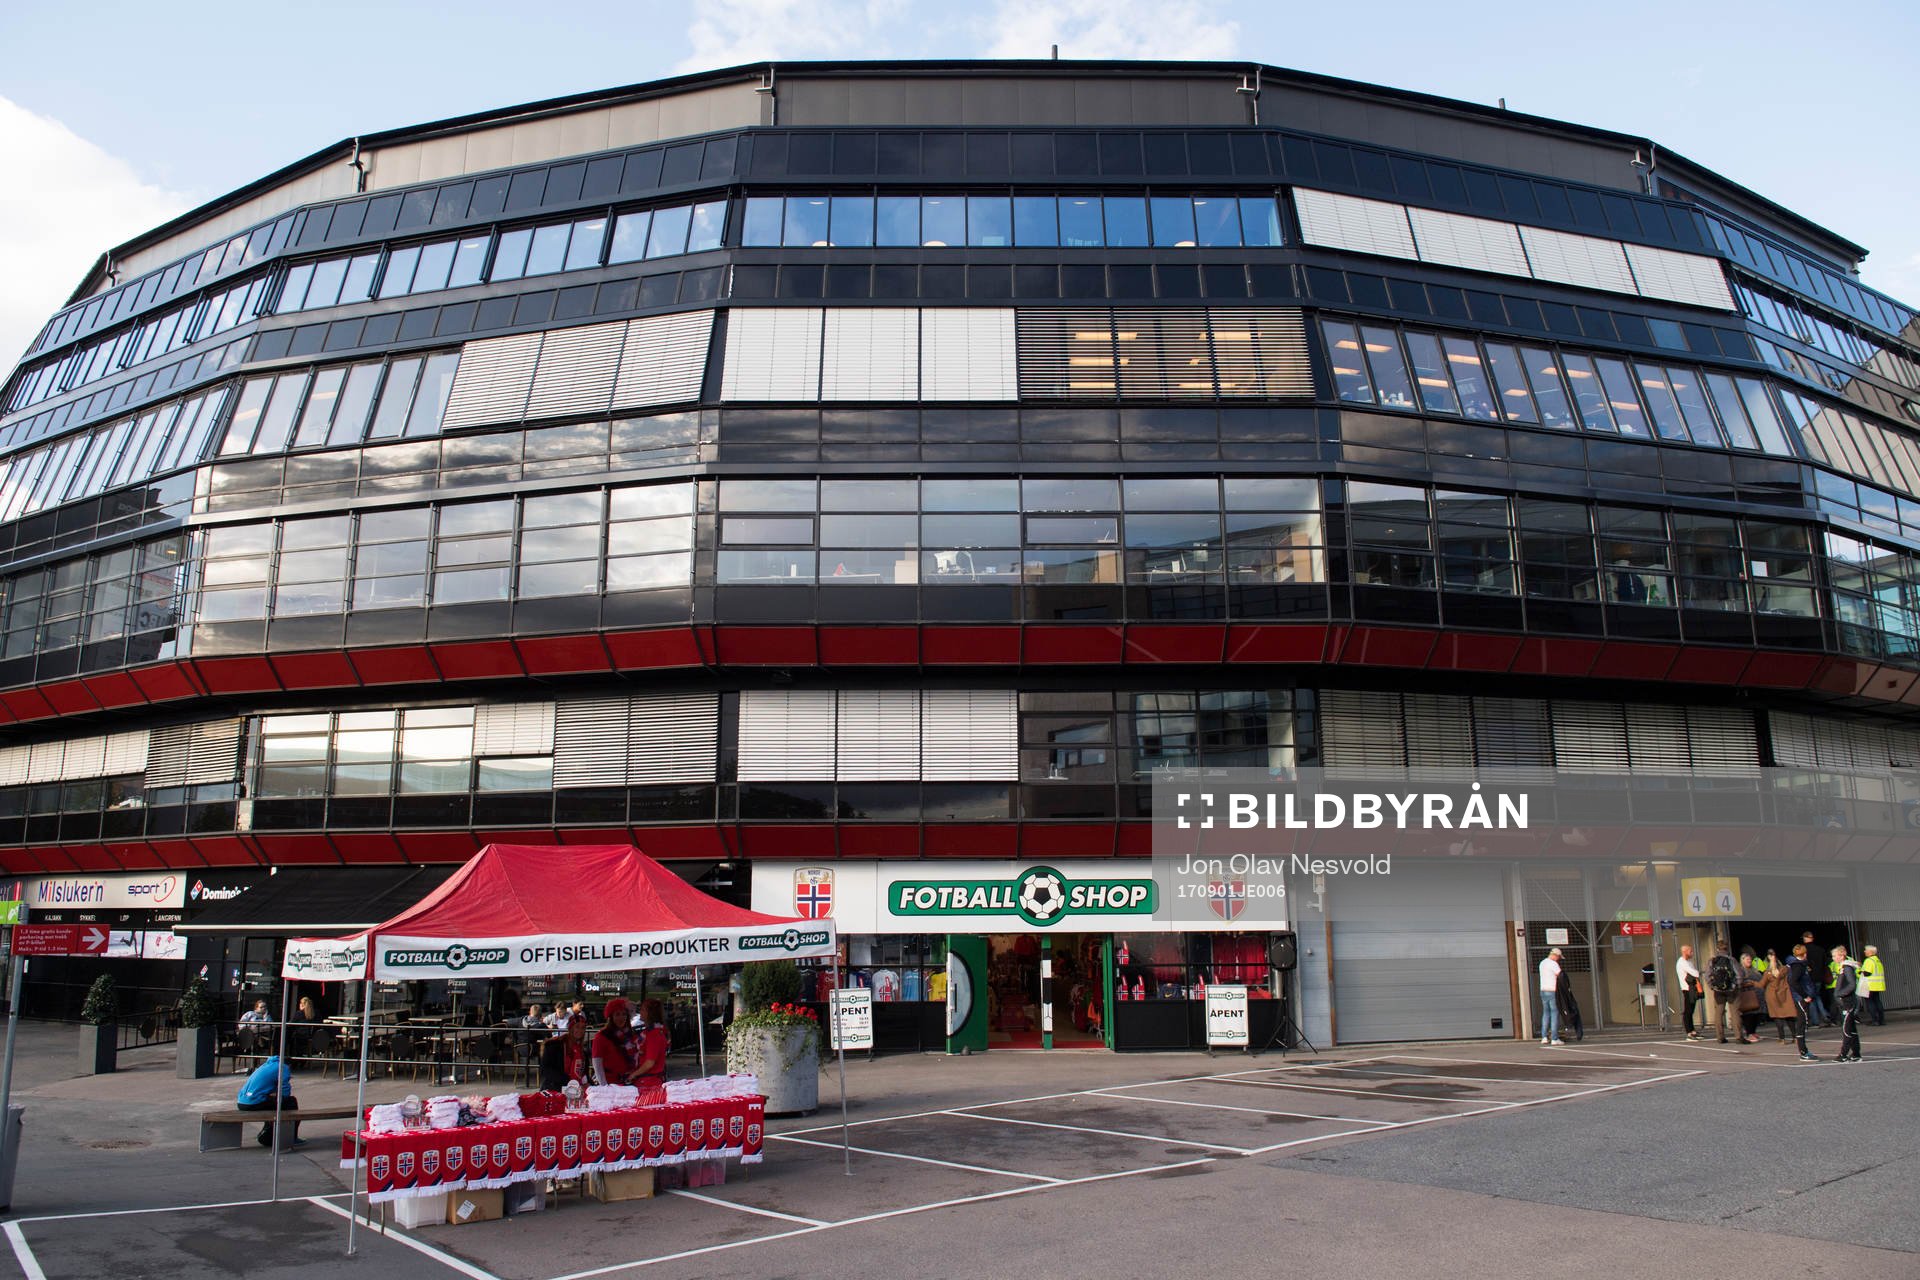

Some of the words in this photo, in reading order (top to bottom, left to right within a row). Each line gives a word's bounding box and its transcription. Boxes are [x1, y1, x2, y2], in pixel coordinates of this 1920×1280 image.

[128, 884, 160, 896] sport
[899, 886, 1016, 909] FOTBALL
[1068, 886, 1148, 908] SHOP
[1692, 895, 1702, 912] 4
[1721, 895, 1731, 911] 4
[742, 936, 783, 947] FOTBALL
[800, 933, 826, 944] SHOP
[389, 951, 445, 964] FOTBALL
[469, 950, 505, 962] SHOP
[520, 944, 623, 963] OFFISIELLE
[628, 937, 729, 958] PRODUKTER
